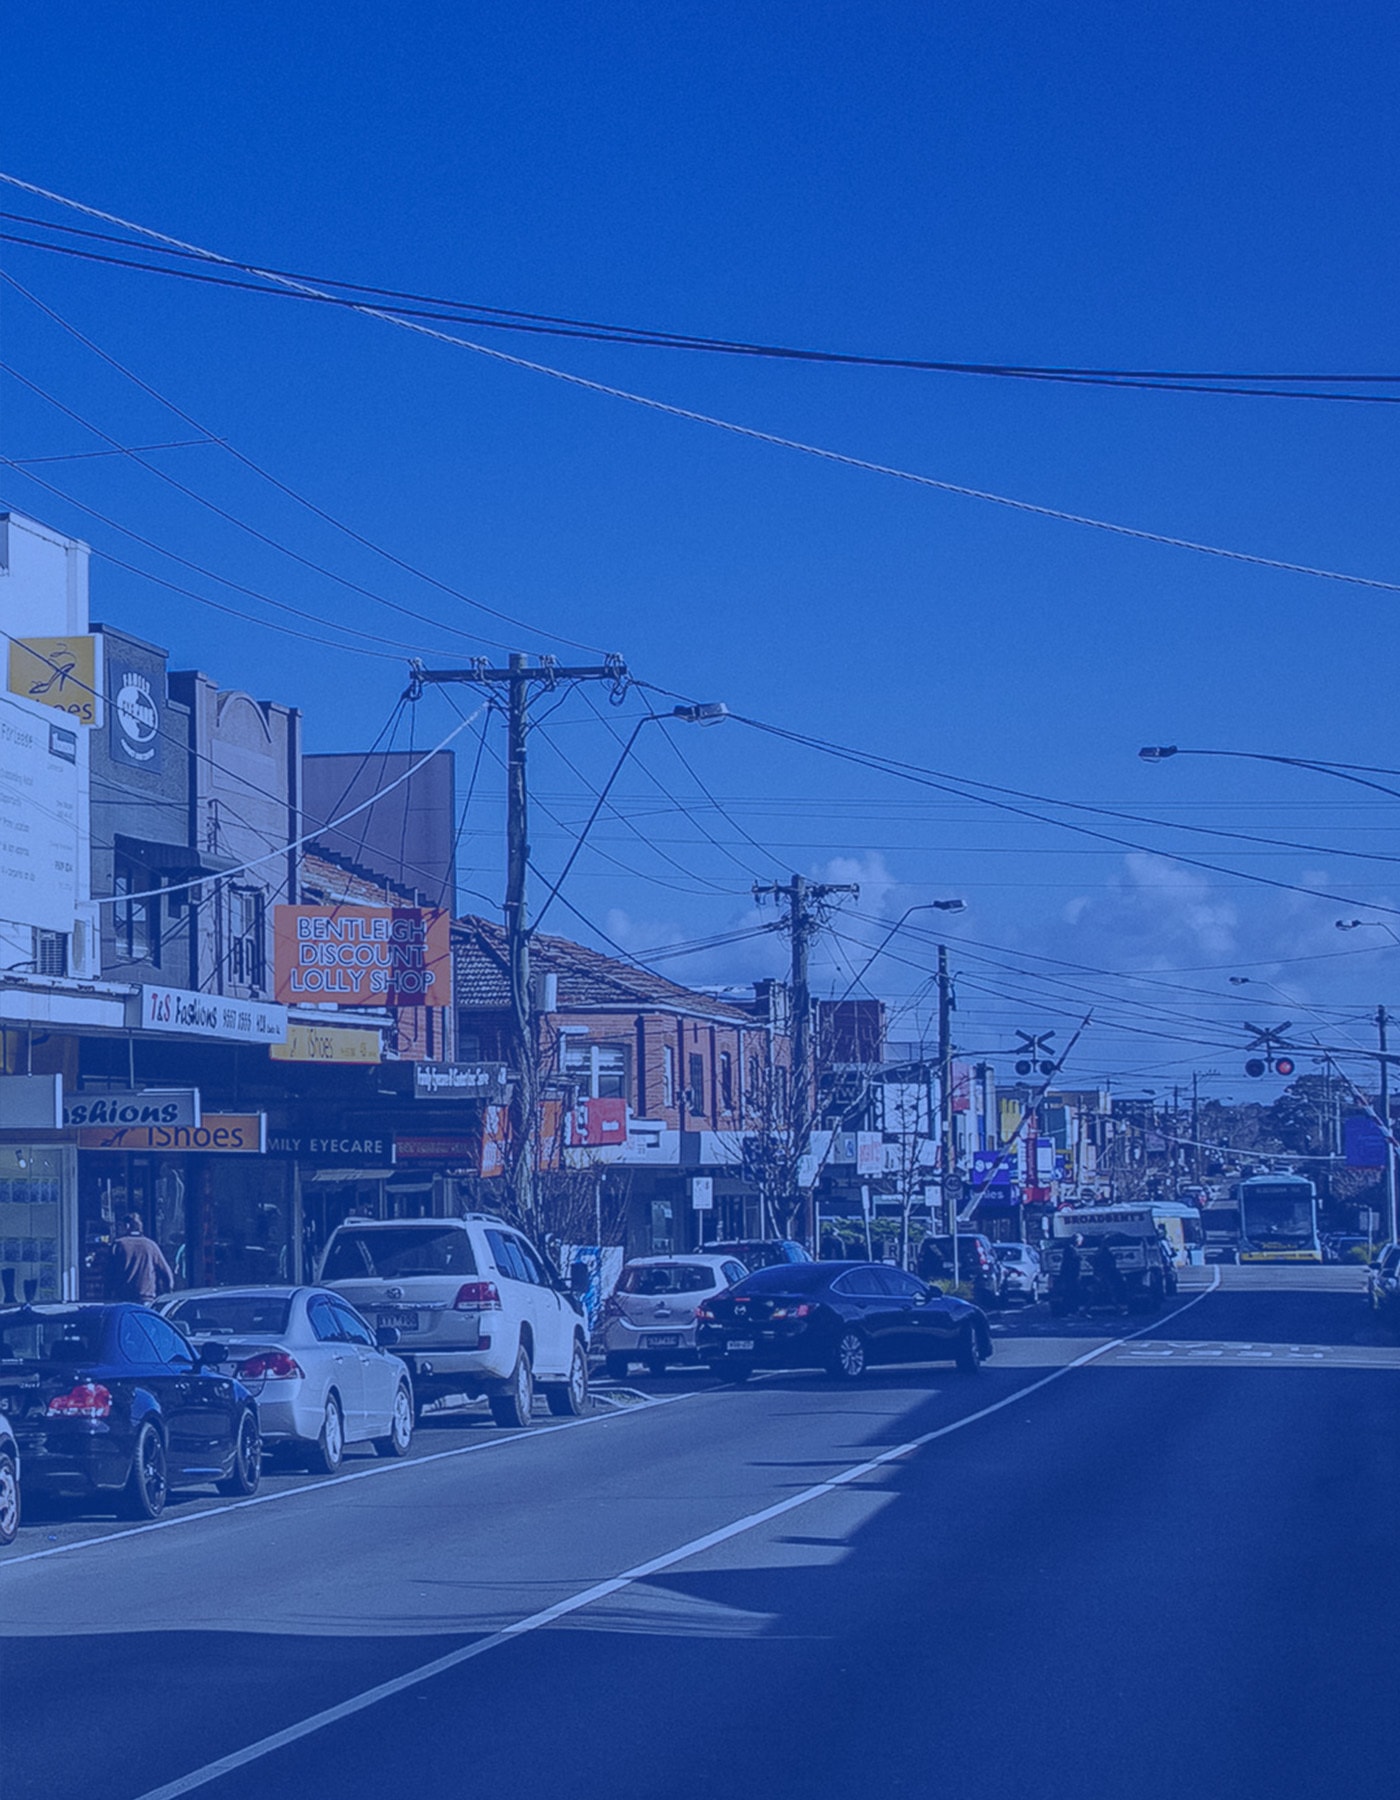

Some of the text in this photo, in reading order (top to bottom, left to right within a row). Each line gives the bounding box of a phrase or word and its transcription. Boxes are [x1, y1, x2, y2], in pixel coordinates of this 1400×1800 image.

[297, 916, 428, 943] BENTLEIGH
[299, 942, 428, 968] DISCOUNT
[291, 968, 436, 994] LOLLY SHOP
[151, 993, 171, 1023] T&S
[64, 1100, 179, 1125] shions
[267, 1138, 302, 1152] MILY
[310, 1138, 383, 1154] EYECARE
